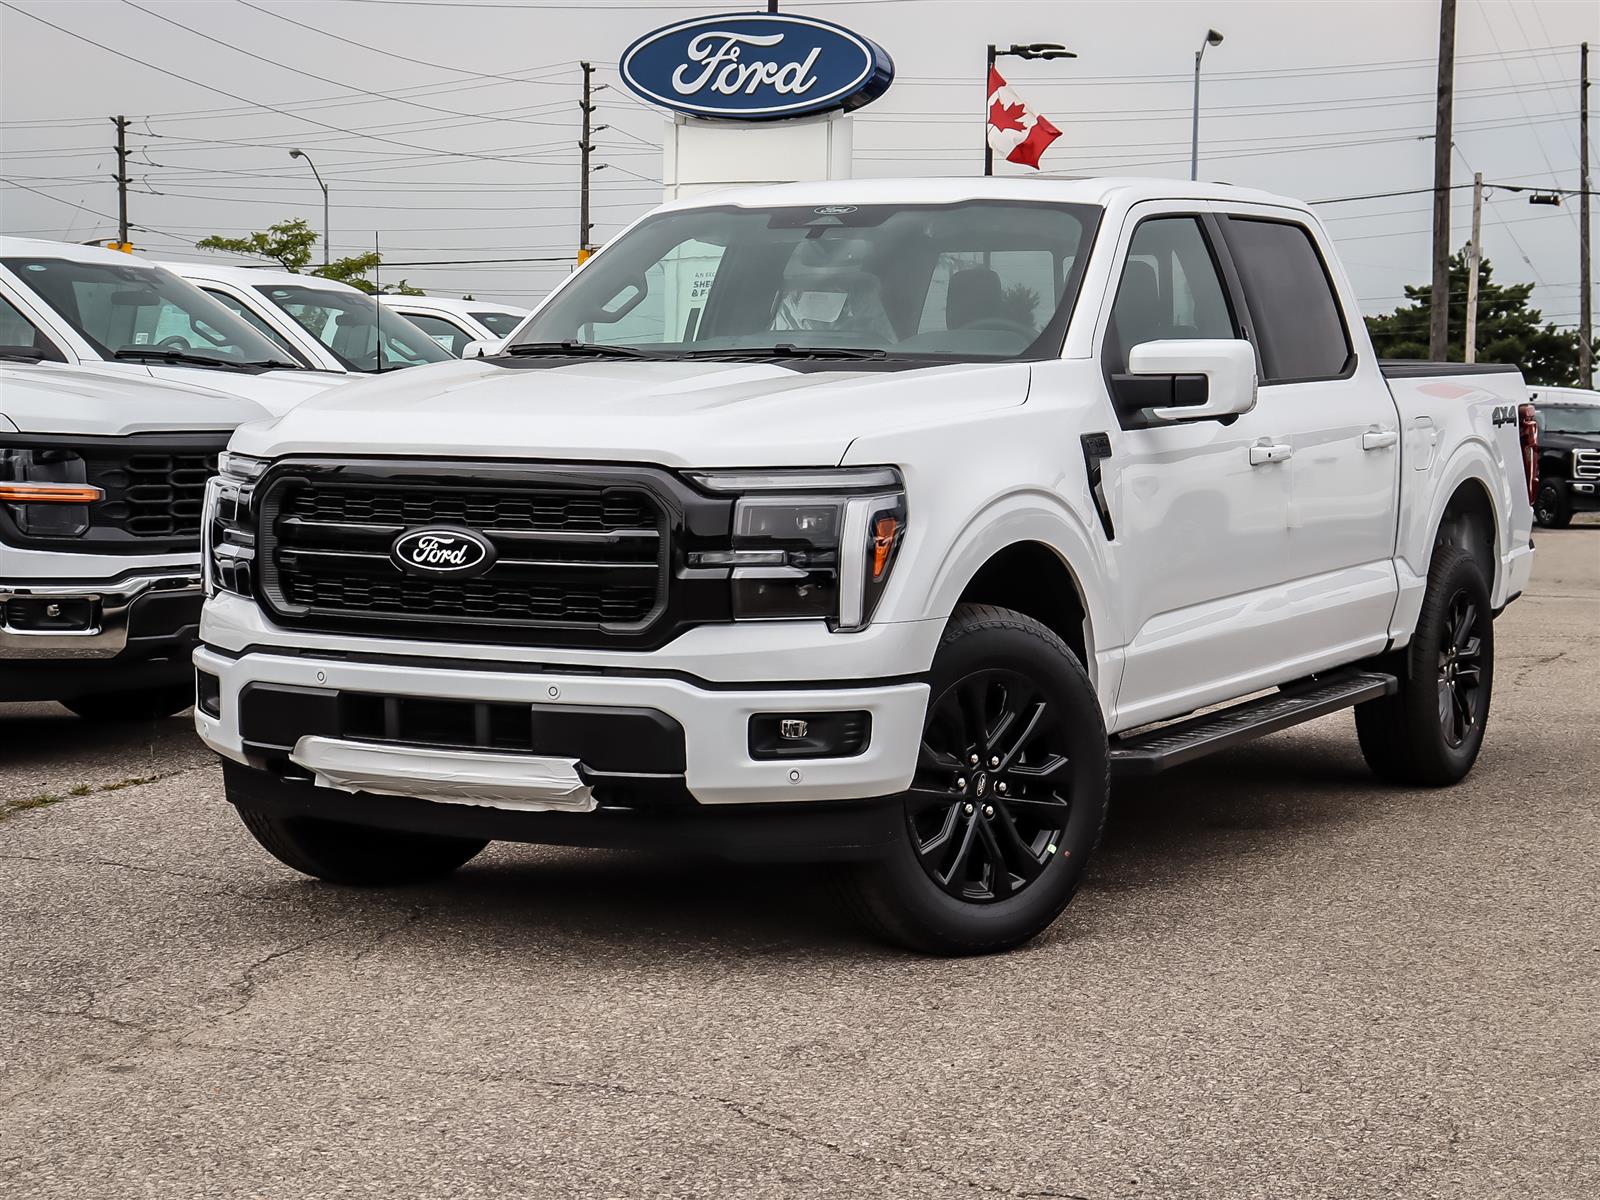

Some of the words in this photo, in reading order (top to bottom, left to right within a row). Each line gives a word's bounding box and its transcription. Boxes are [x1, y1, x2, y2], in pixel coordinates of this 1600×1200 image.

[672, 31, 822, 95] Ford
[1491, 405, 1517, 429] 4X4
[412, 536, 468, 565] Ford
